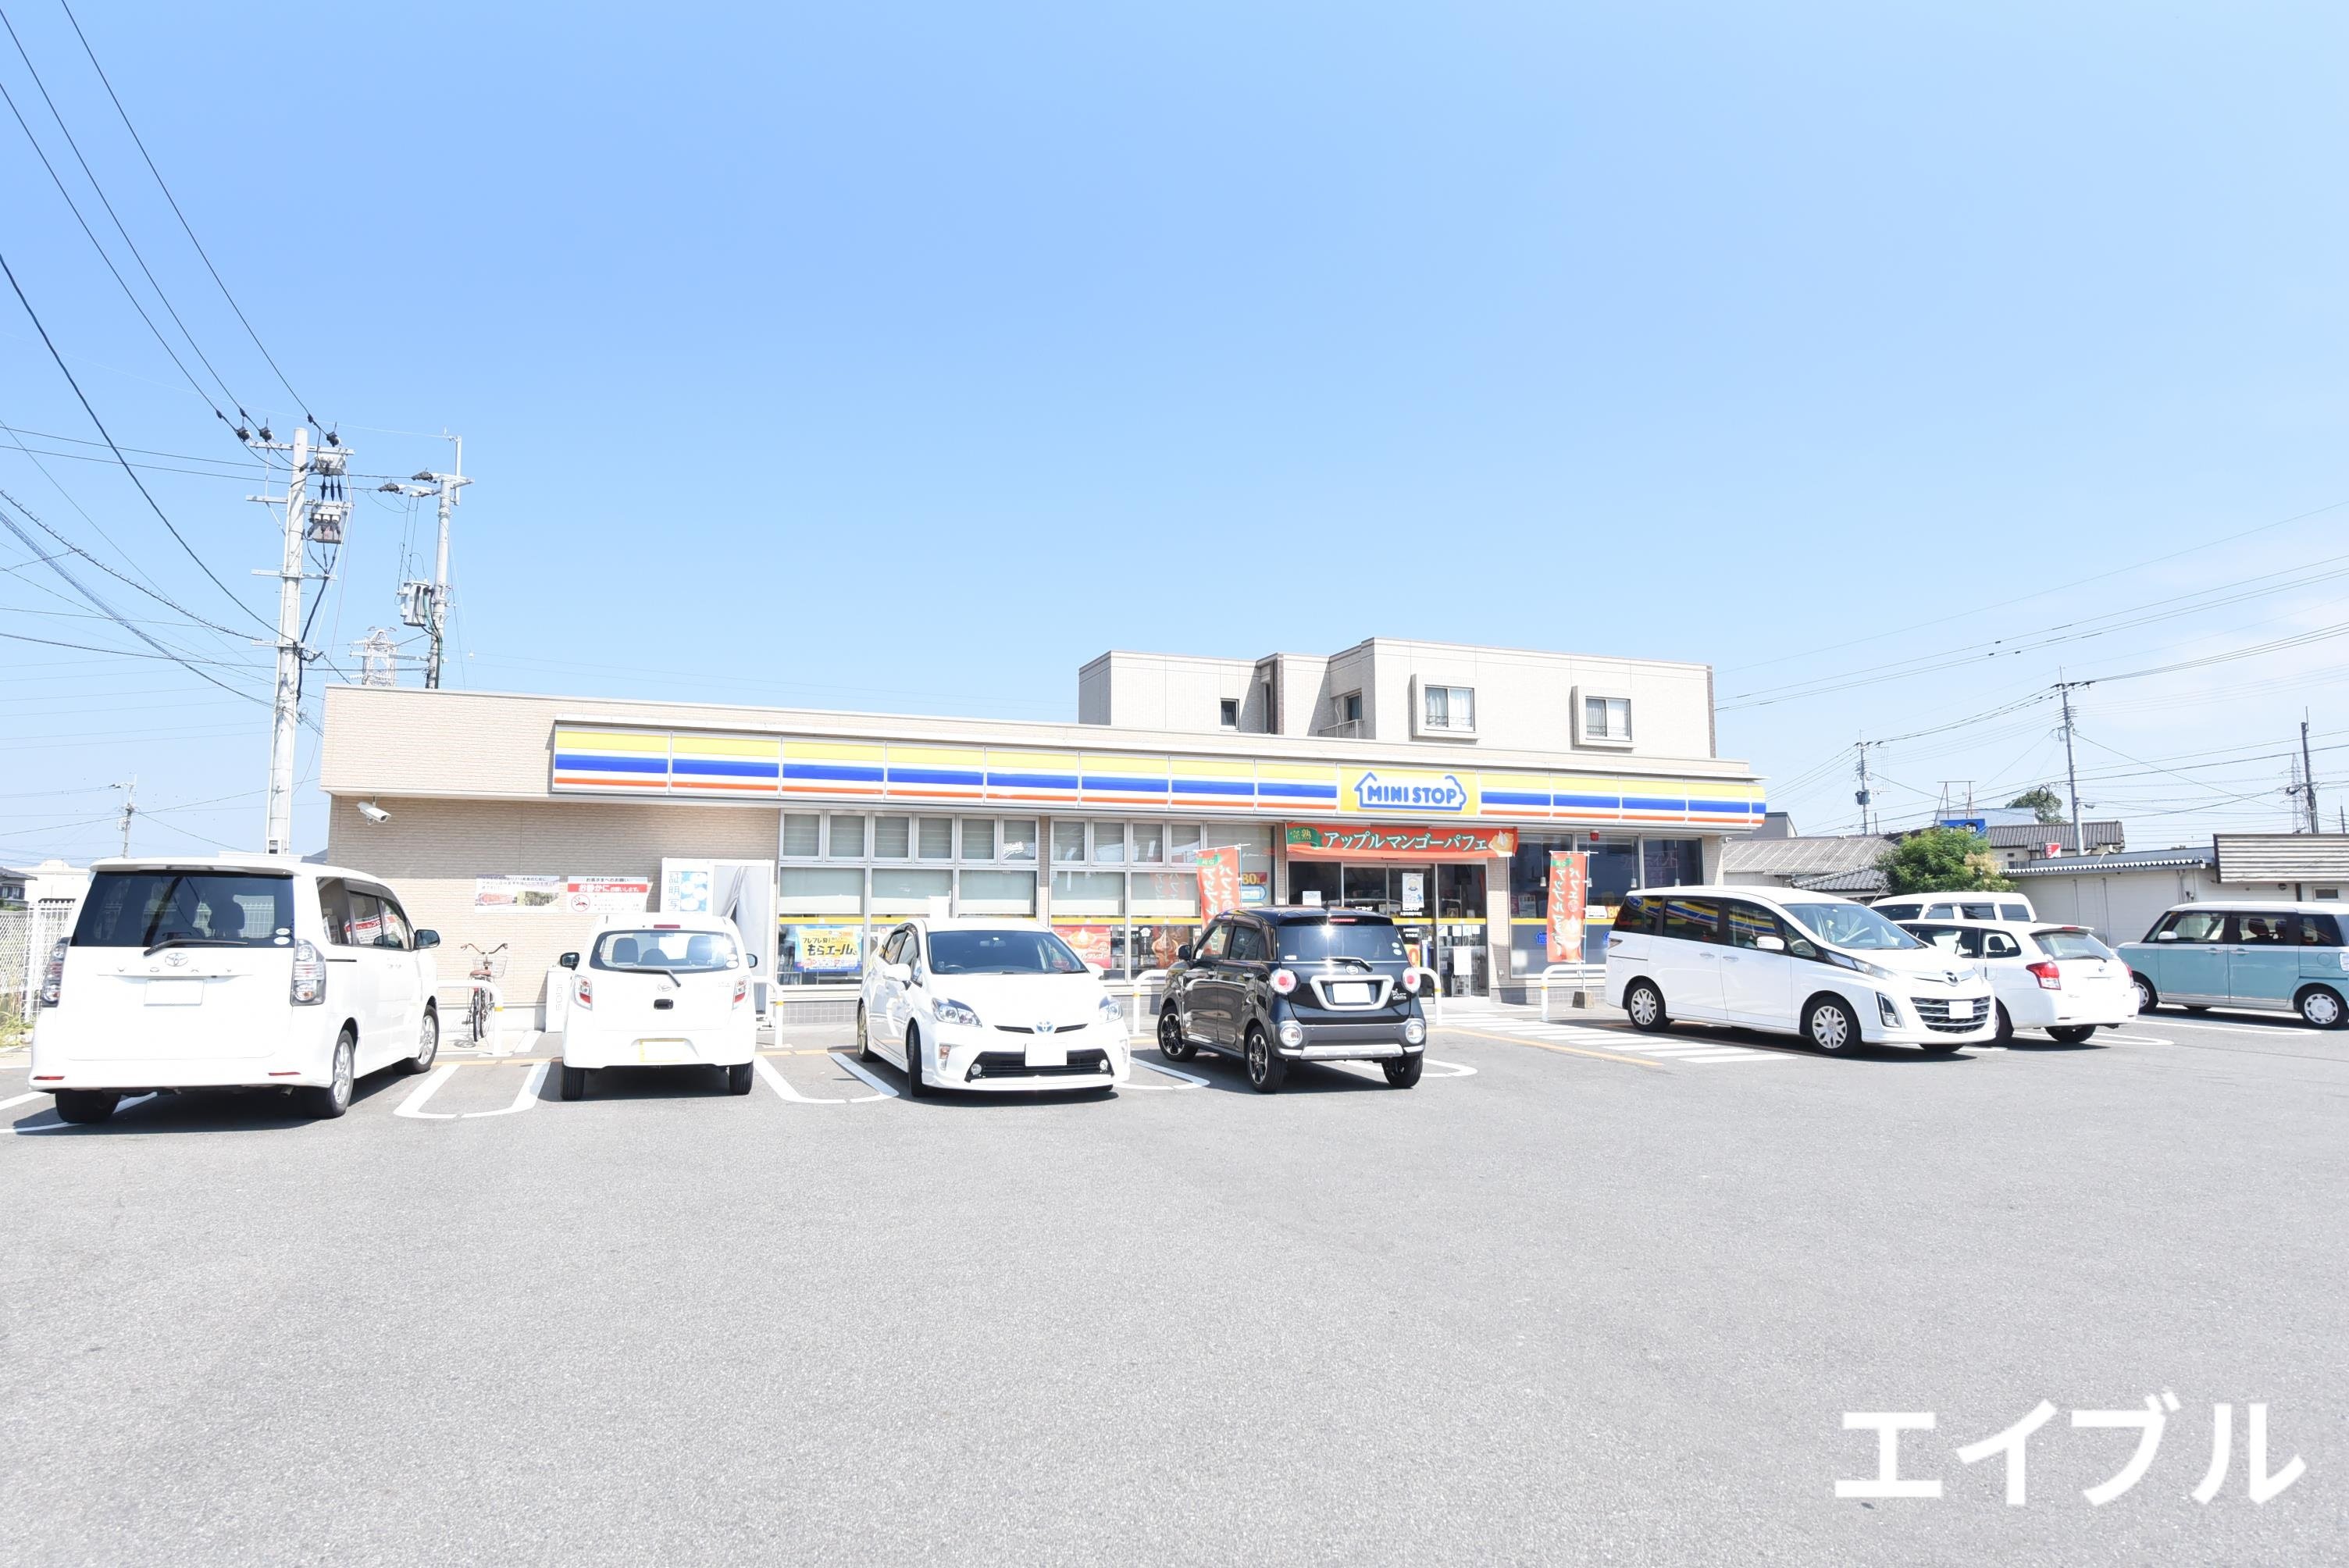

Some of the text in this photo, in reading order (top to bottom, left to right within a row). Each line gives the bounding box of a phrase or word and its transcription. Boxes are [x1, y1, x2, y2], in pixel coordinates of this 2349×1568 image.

[1367, 786, 1457, 804] MINI STOP
[1324, 830, 1488, 851] アップルマンゴーパフェ
